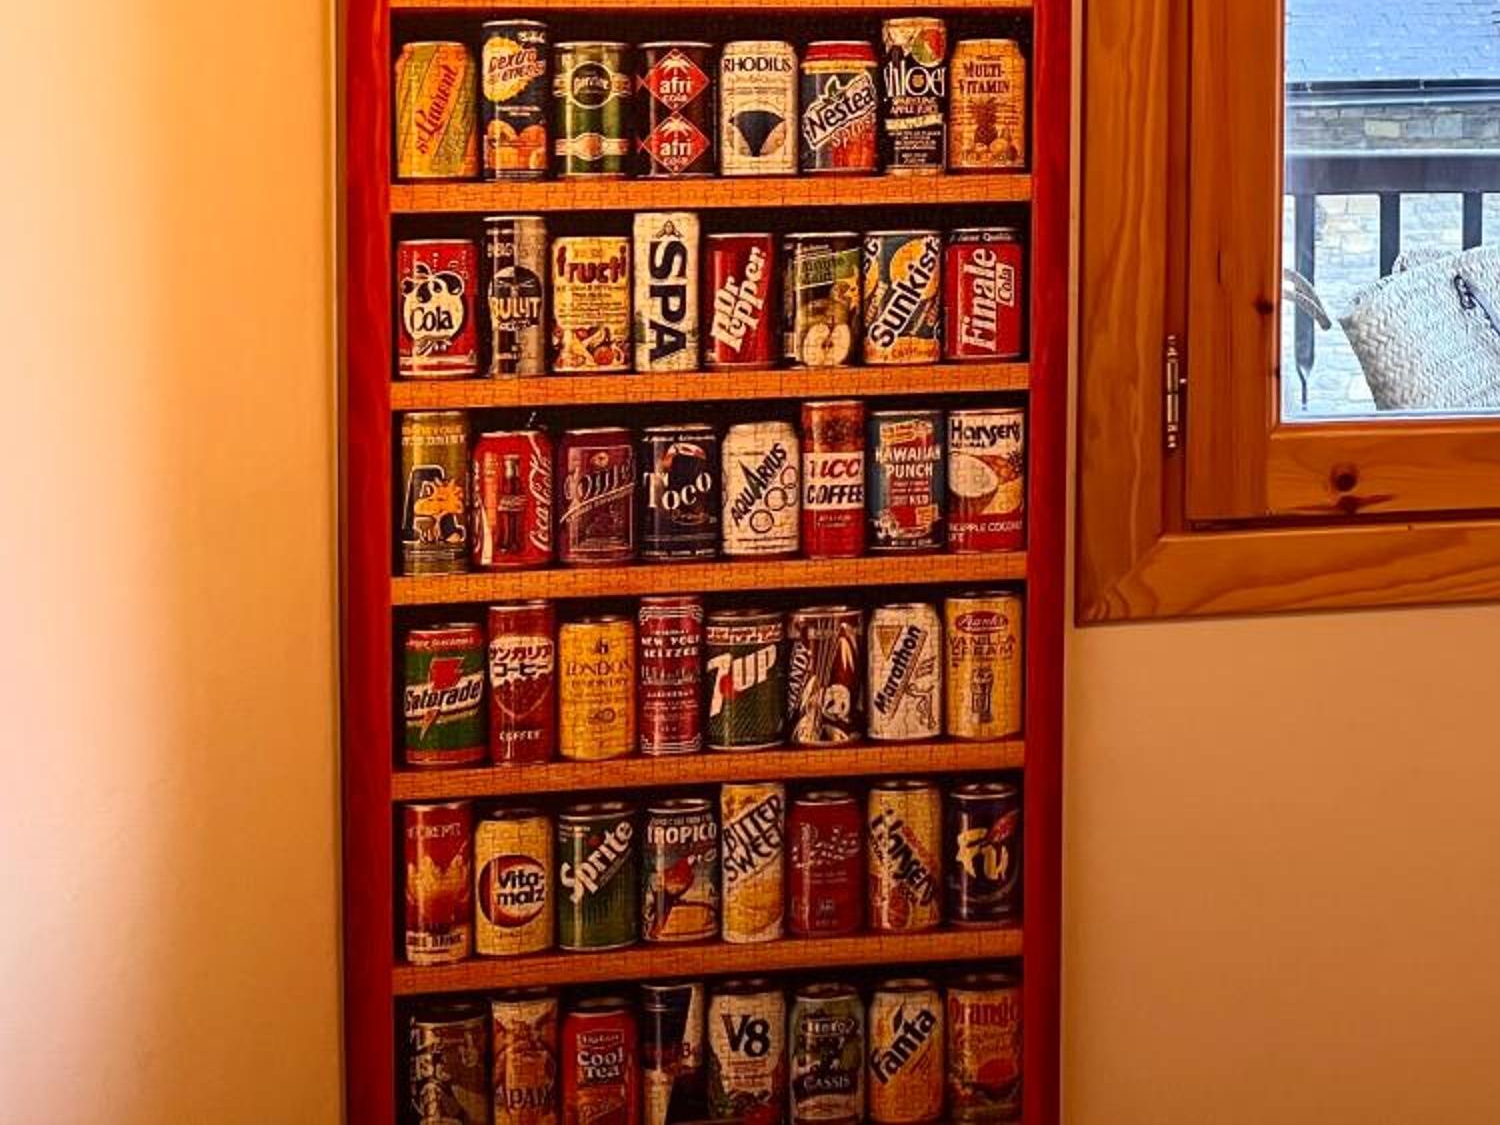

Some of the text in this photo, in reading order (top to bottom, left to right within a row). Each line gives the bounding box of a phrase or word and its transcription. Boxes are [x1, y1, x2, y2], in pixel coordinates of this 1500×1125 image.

[723, 56, 793, 74] RHODIUS
[659, 77, 692, 95] afri
[806, 84, 876, 140] Nestea
[659, 139, 692, 157] afri
[649, 240, 688, 362] SPA
[868, 235, 943, 348] Sunkist
[960, 248, 997, 352] Finale
[409, 306, 453, 332] Cola
[885, 462, 933, 479] PUNCH
[873, 624, 922, 715] Marathon
[405, 679, 483, 711] Gatorade
[719, 1013, 771, 1058] V8
